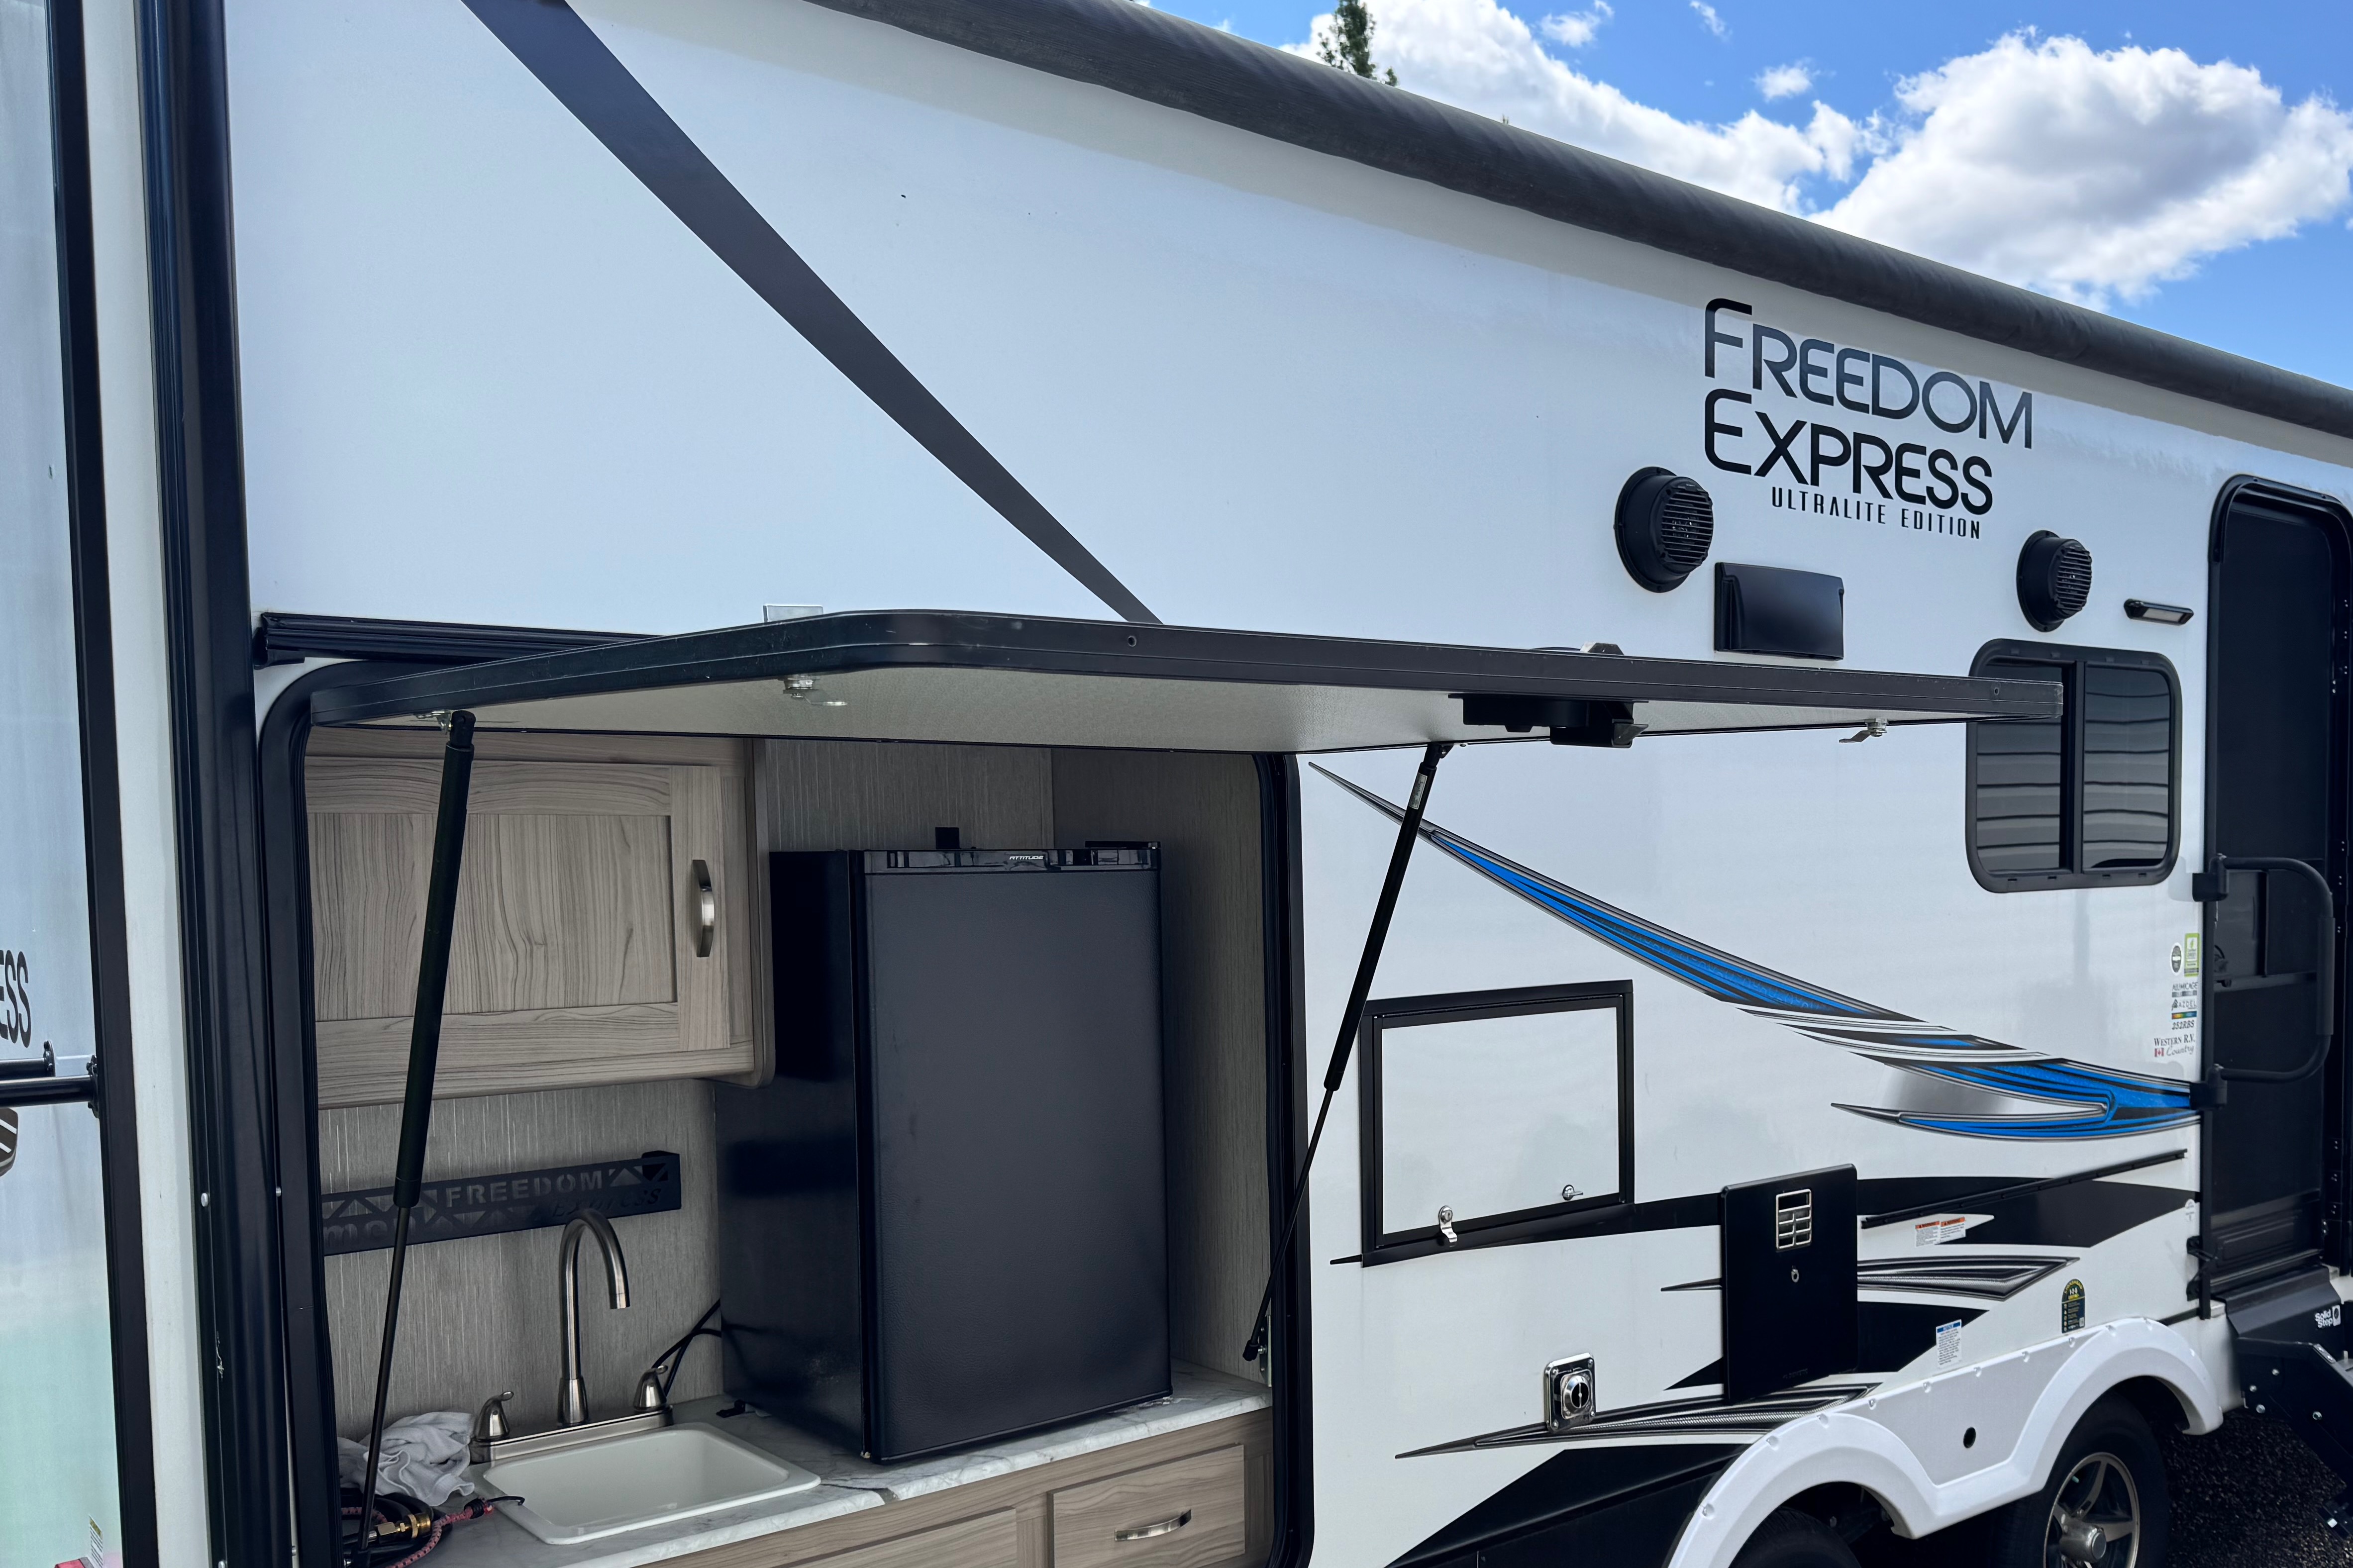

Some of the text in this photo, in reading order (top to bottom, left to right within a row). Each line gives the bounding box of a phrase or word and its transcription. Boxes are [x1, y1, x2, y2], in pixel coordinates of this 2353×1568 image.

[1705, 298, 2032, 449] FREEDOM
[1705, 389, 1993, 515] EXPRESS
[1772, 486, 1980, 540] ULTRALITE EDITION
[2178, 999, 2197, 1008] AZDEL
[2172, 1020, 2194, 1030] 252RBS
[446, 1171, 603, 1208] FREEDOM
[2315, 1309, 2331, 1322] Solid
